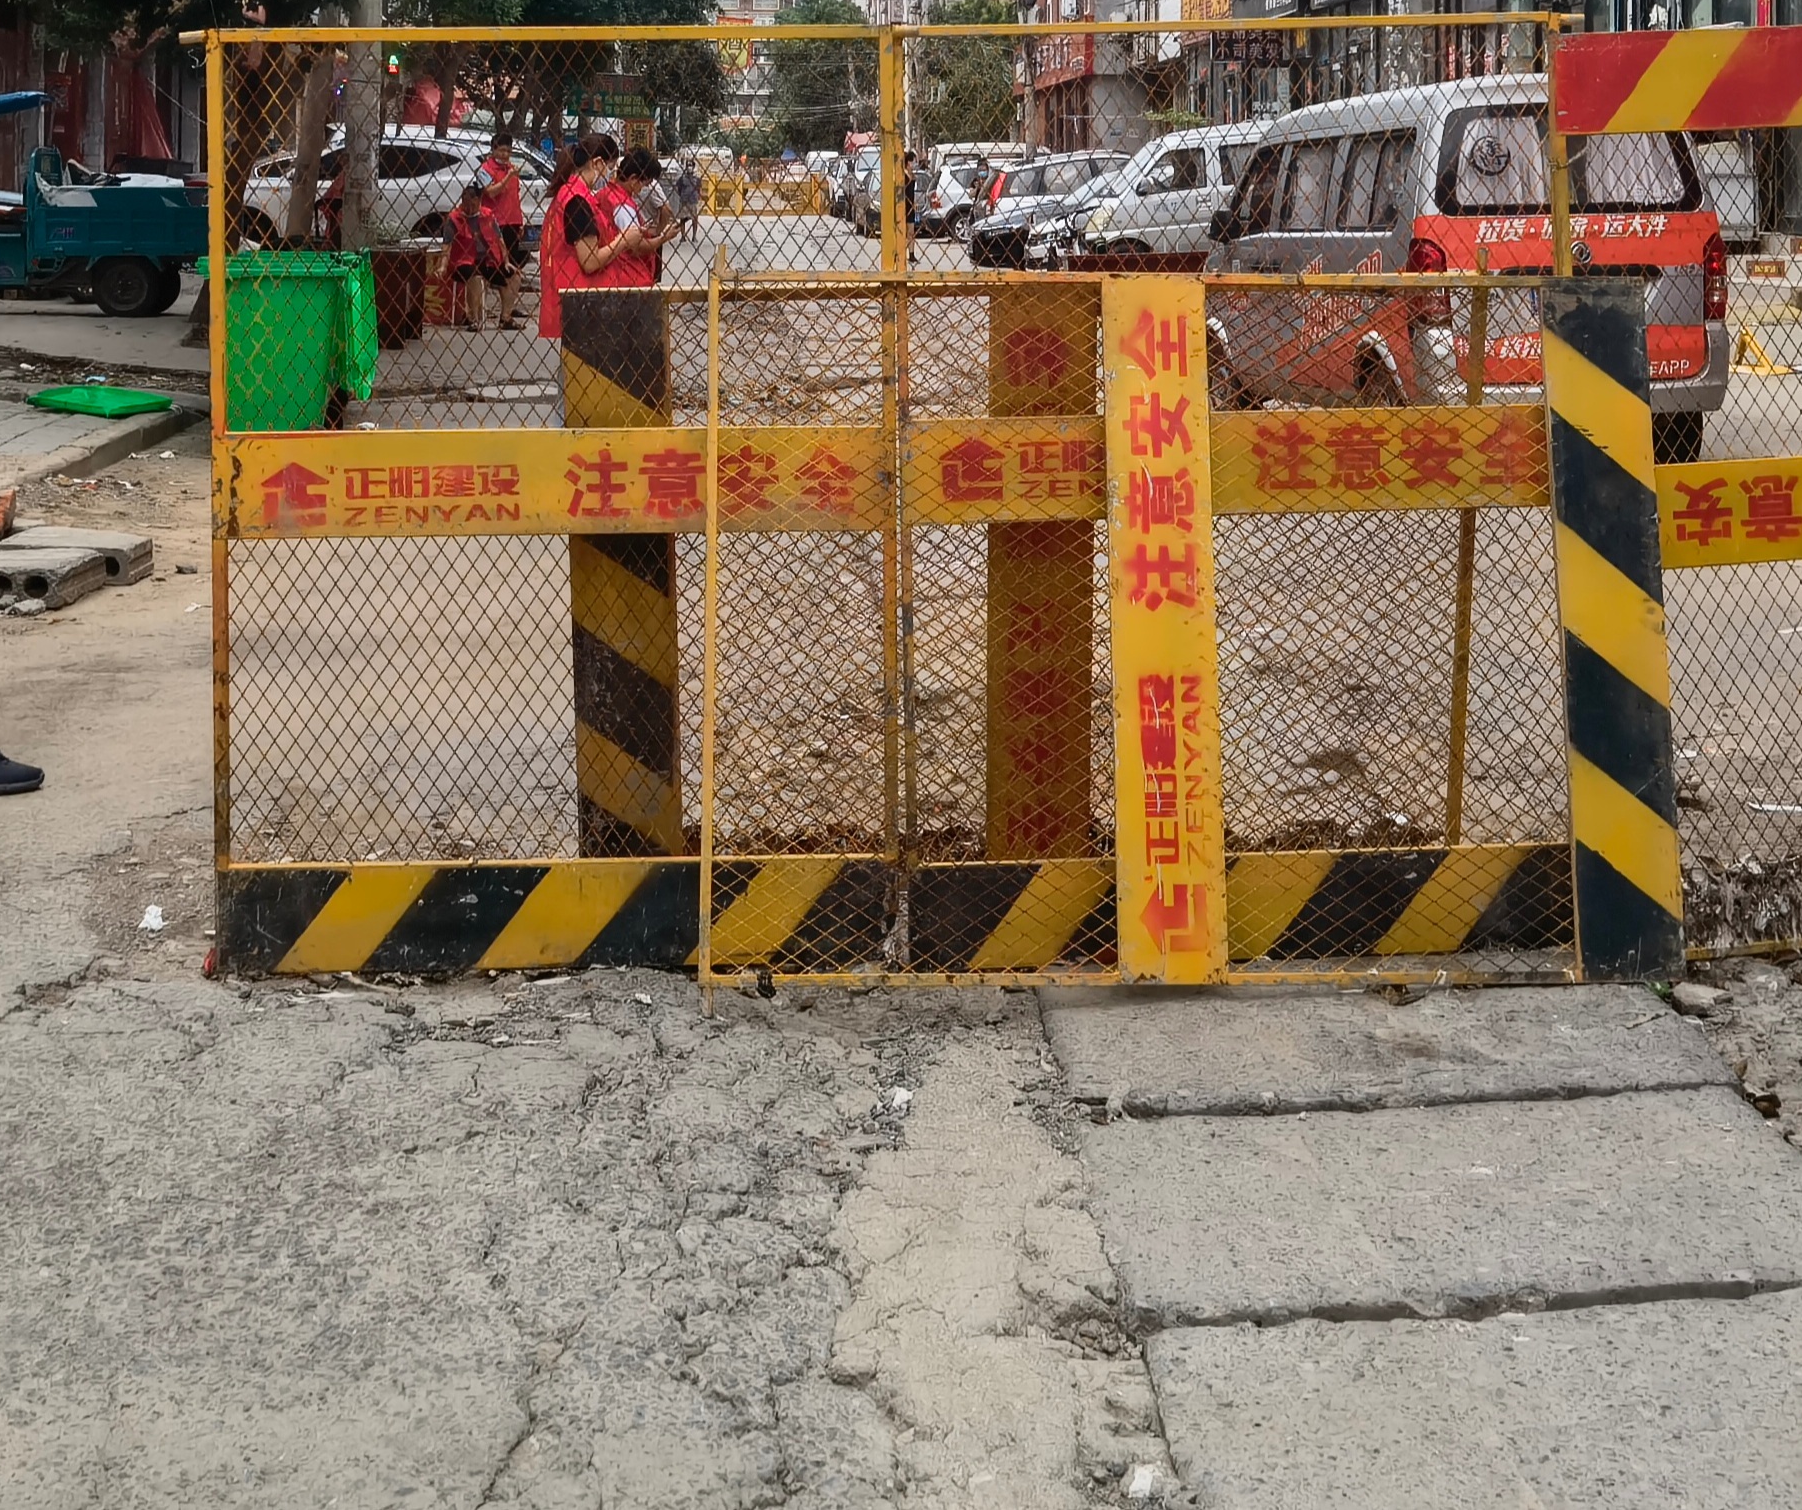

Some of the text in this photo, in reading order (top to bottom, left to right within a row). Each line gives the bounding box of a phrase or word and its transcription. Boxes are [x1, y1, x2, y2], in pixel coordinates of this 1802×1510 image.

[563, 444, 860, 521] 注意安全
[1119, 308, 1197, 613] 注意安全
[1250, 407, 1545, 492] 注意安全
[343, 502, 521, 528] ZENYAN
